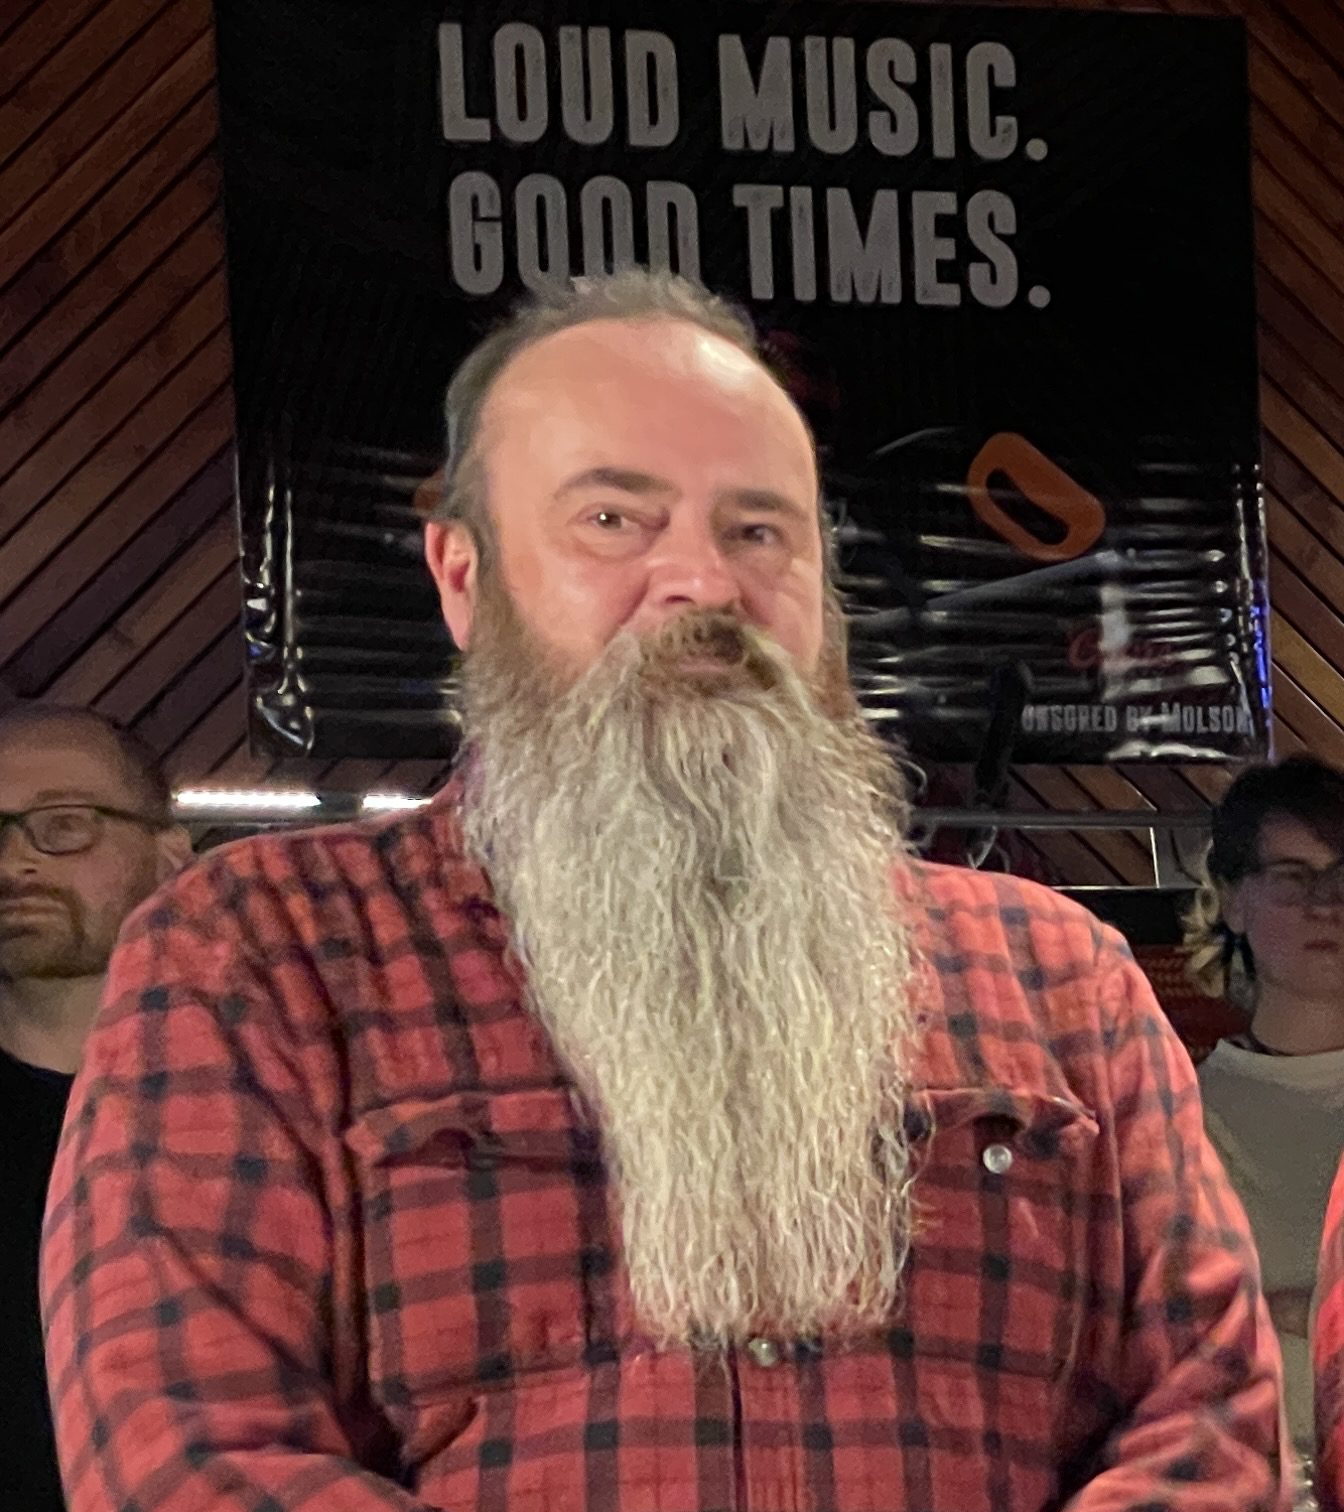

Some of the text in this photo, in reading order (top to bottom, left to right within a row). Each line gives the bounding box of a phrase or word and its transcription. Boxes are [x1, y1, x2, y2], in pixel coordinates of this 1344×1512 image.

[438, 21, 1049, 162] LOUD MUSIC.
[448, 170, 1052, 309] GOOD TIMES.
[1020, 704, 1118, 732] ONSORED
[1158, 701, 1252, 732] MOLSON
